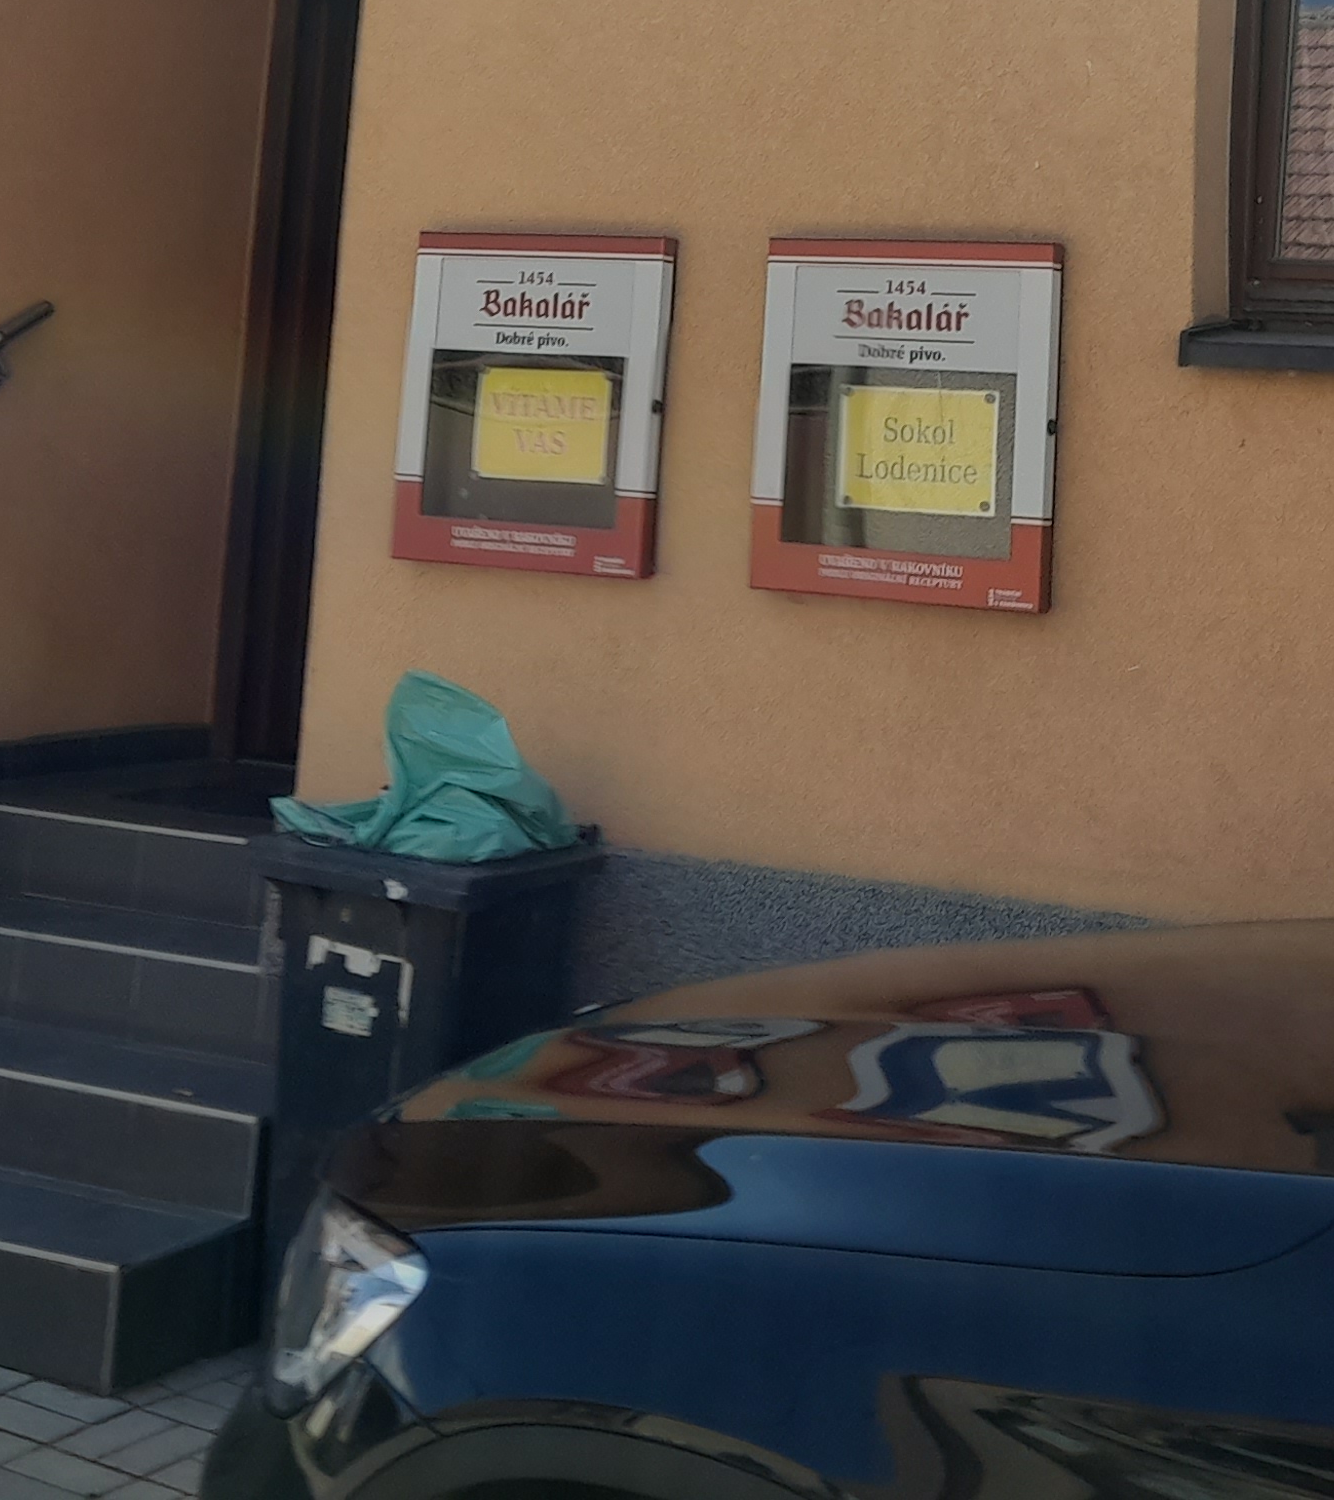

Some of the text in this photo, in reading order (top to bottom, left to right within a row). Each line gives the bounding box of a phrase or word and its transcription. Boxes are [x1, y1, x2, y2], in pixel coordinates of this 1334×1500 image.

[518, 270, 554, 286] 1454
[885, 279, 927, 296] 1454
[478, 288, 591, 320] Bakalář
[841, 298, 971, 332] Bakalář
[495, 330, 570, 350] Dobré pivo.
[857, 343, 947, 364] Dobré pivo.
[883, 416, 955, 445] Sokol
[855, 452, 978, 485] Lodenice
